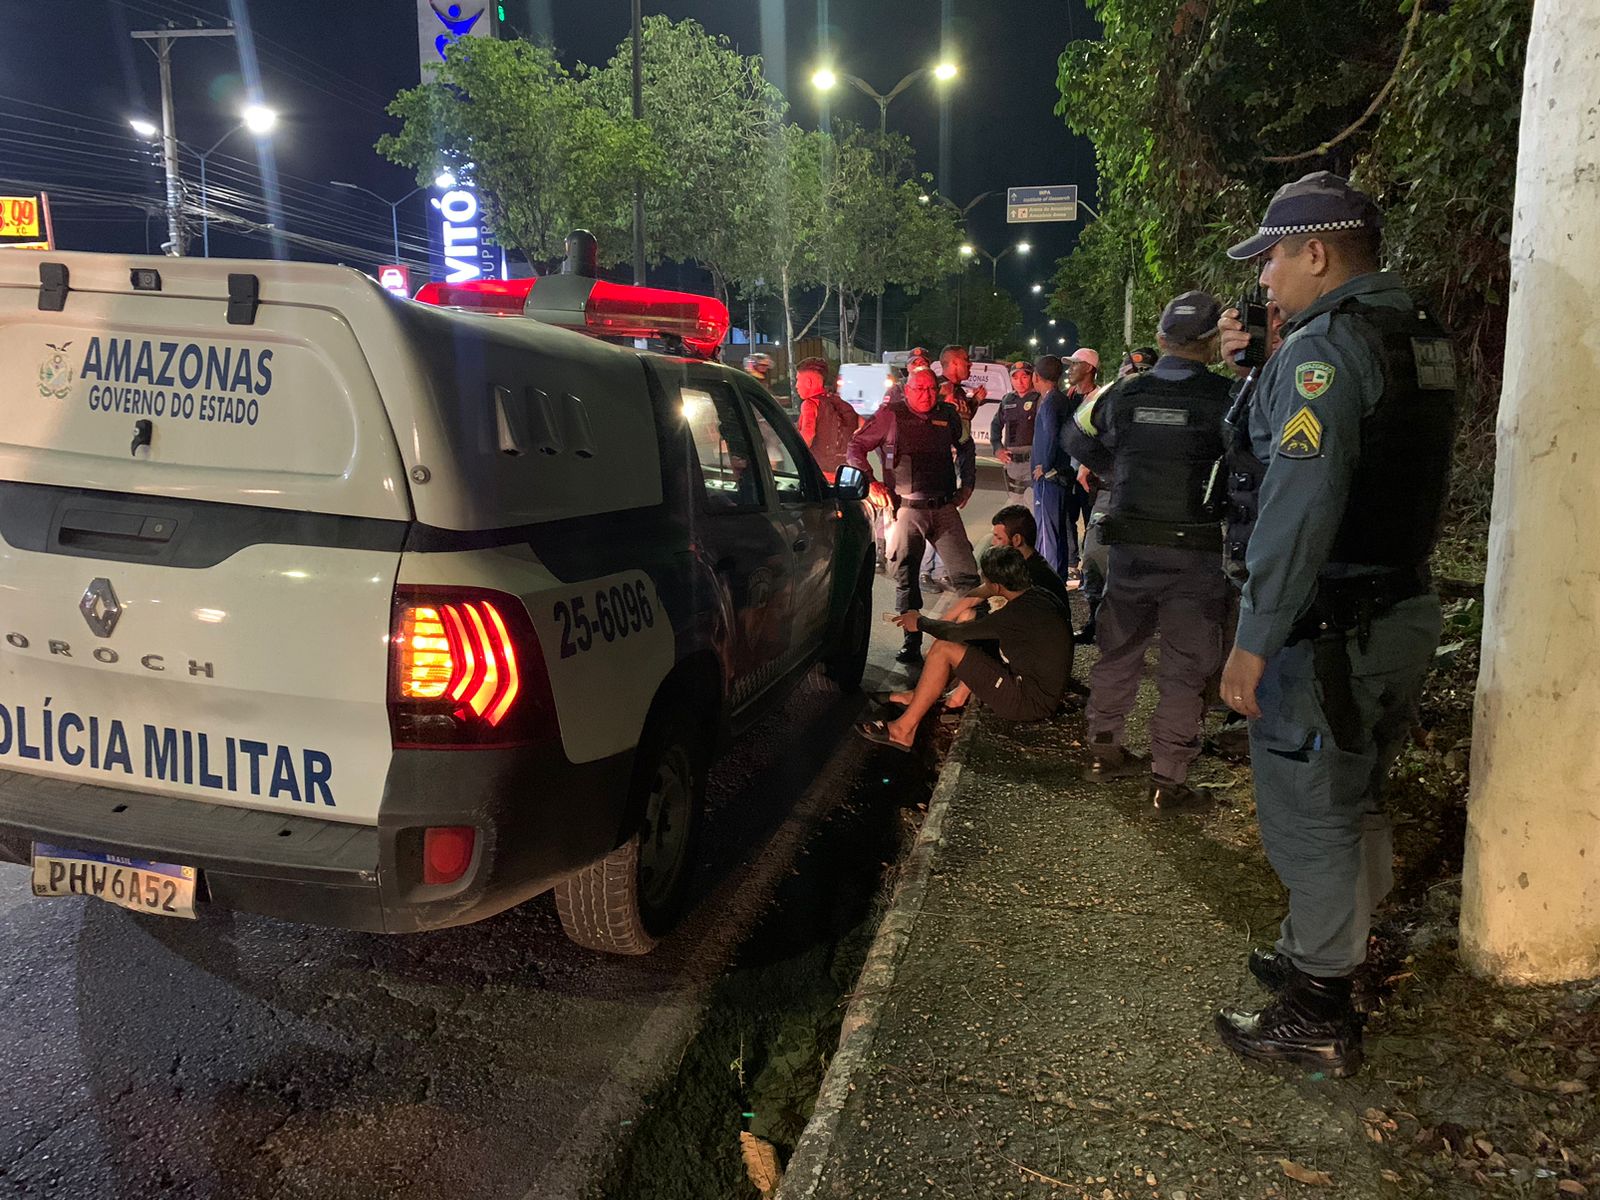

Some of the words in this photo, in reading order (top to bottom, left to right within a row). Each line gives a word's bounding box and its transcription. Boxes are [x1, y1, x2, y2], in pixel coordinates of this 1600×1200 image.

[430, 188, 481, 283] VITÓ
[80, 337, 274, 395] AMAZONAS
[89, 385, 166, 417] GOVERNO
[170, 392, 194, 419] DO
[199, 395, 259, 425] ESTADO
[553, 579, 654, 659] 25-6096
[6, 631, 214, 678] OROCH
[143, 724, 337, 807] MILITAR
[49, 861, 177, 912] PHW6A52
[106, 854, 132, 866] BRASIL
